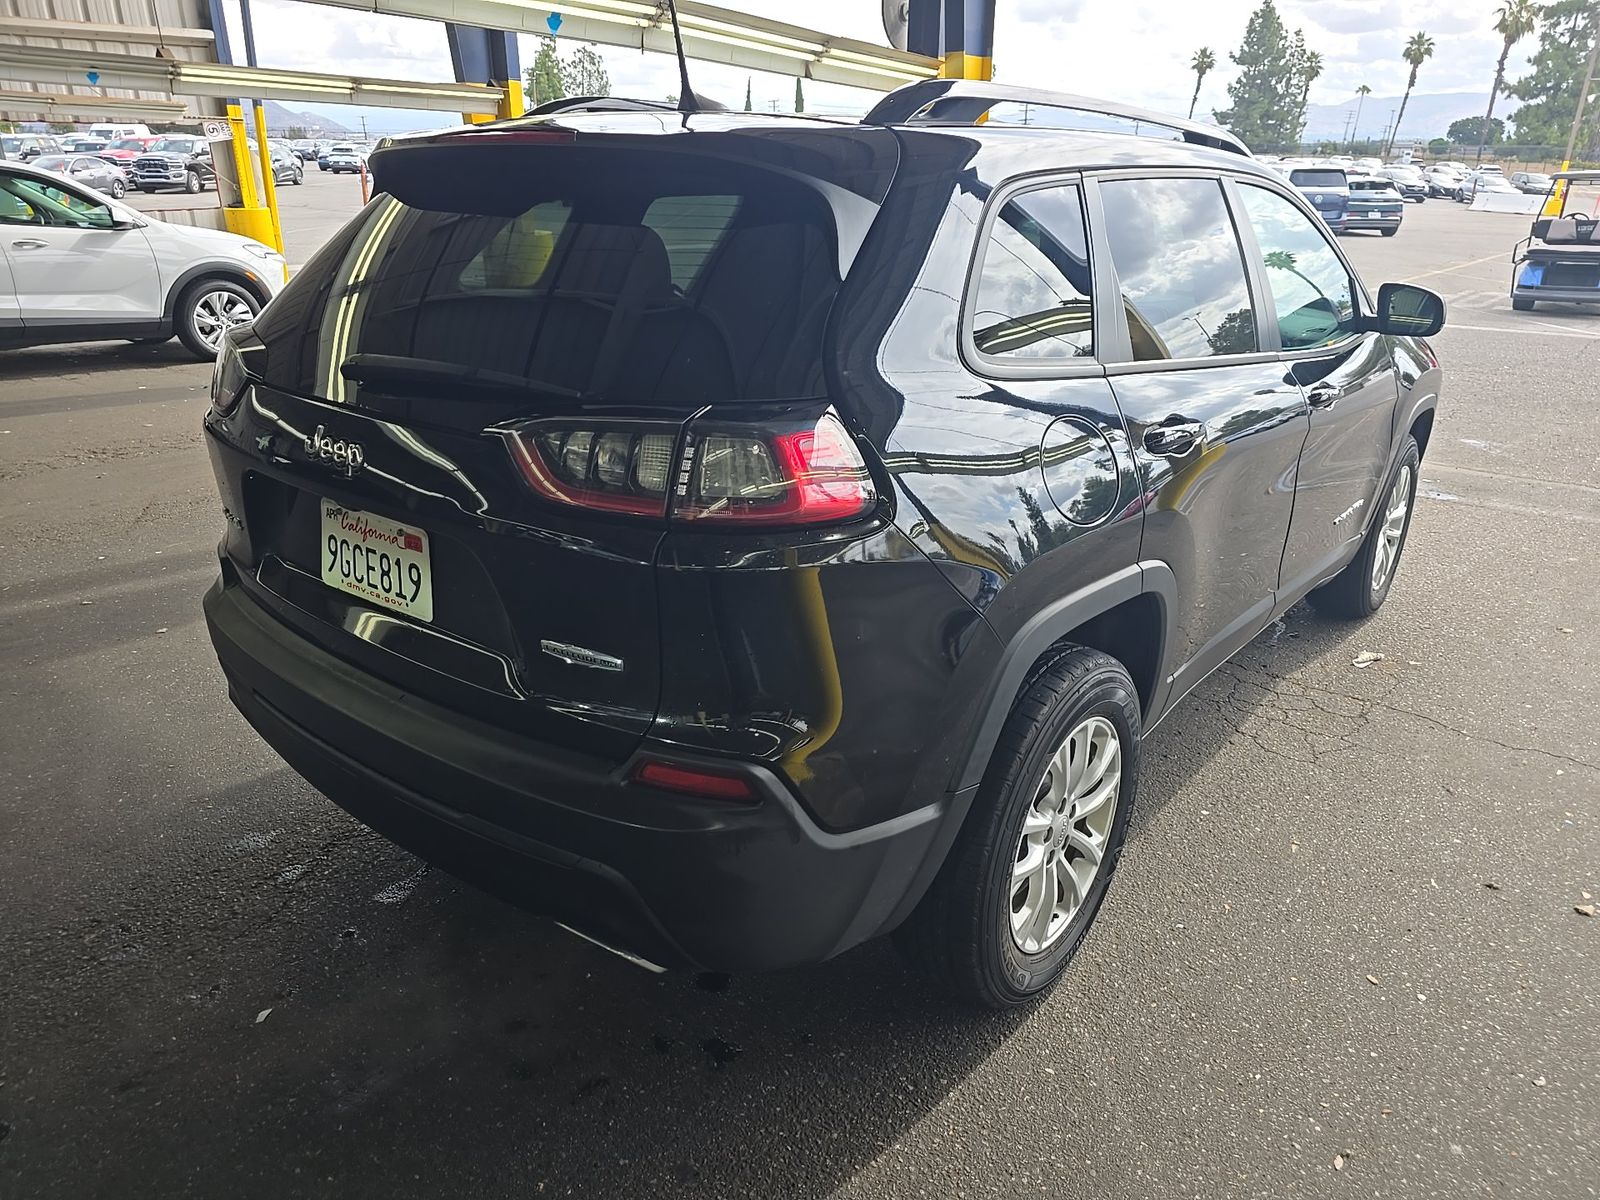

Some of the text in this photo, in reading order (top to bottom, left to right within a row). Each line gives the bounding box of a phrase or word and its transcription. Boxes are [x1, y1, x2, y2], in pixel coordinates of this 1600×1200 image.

[304, 424, 363, 477] Jeep
[341, 511, 406, 549] California
[328, 534, 421, 602] 9GCE819
[346, 582, 403, 606] dmv.ca.gov
